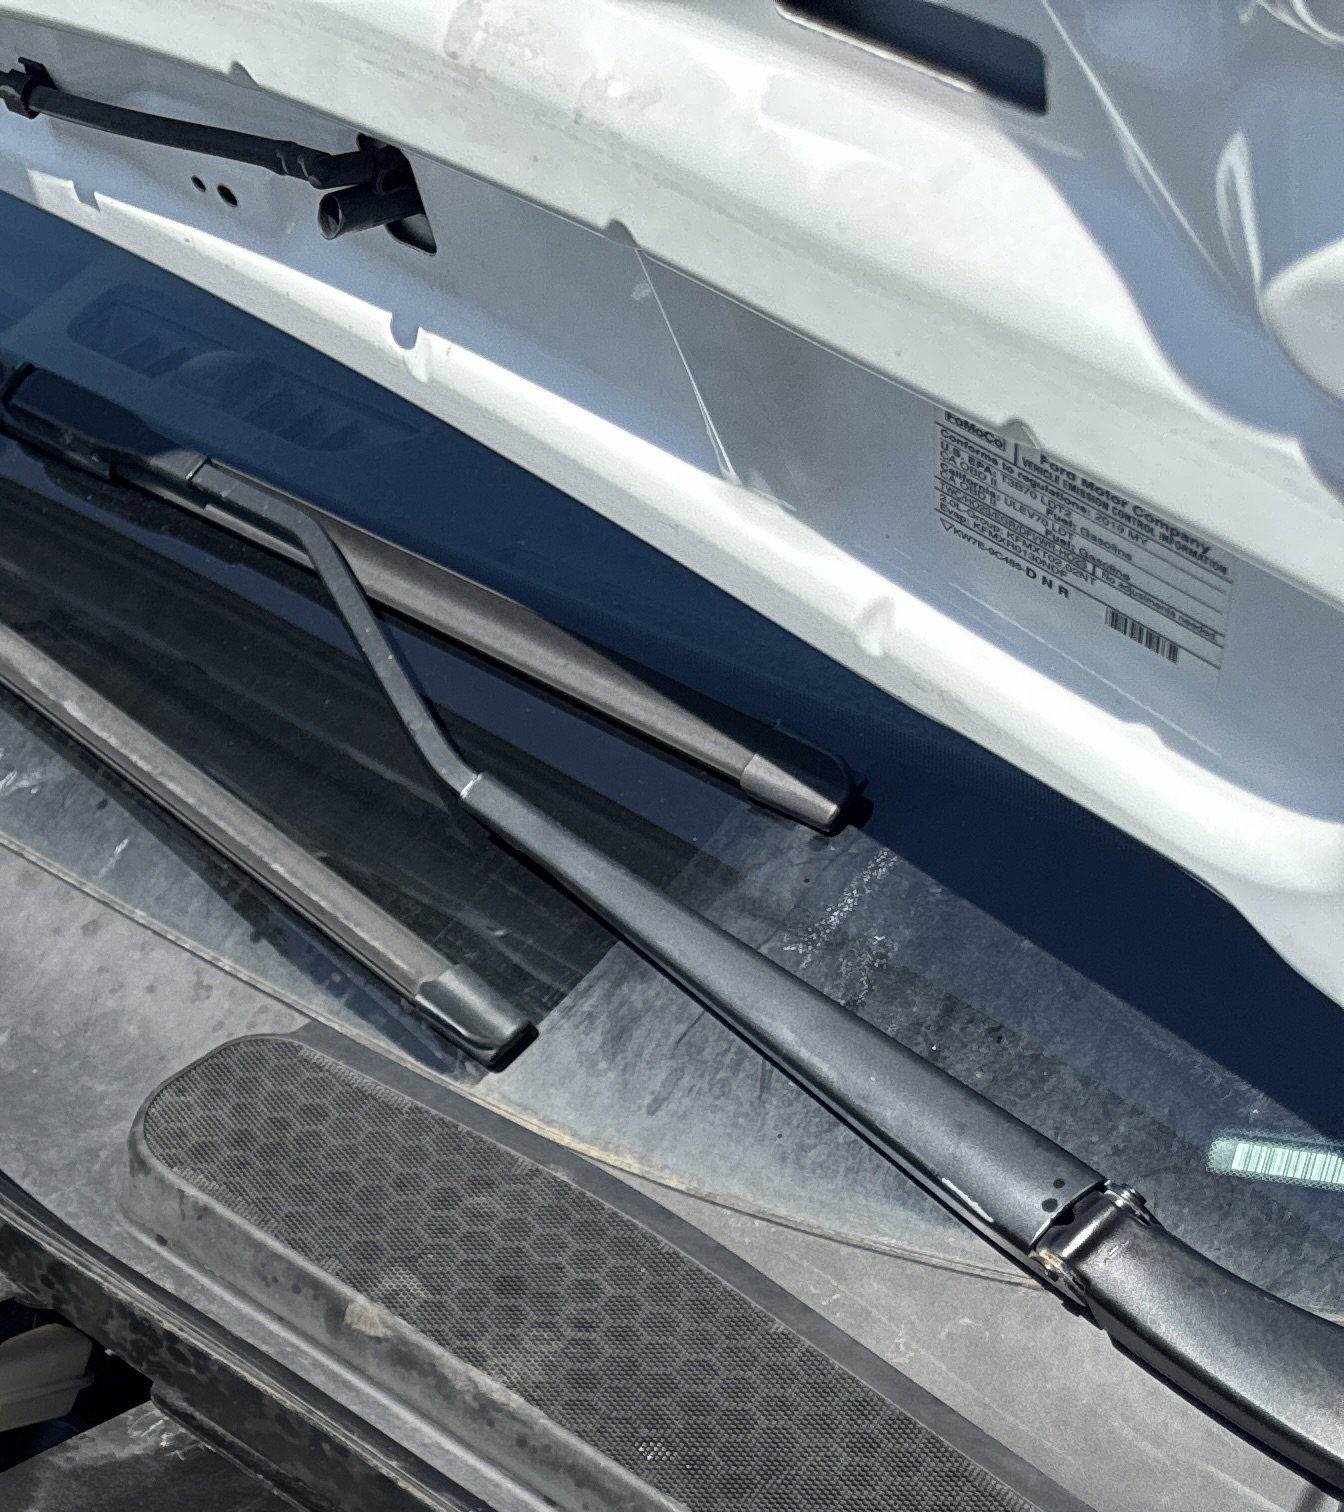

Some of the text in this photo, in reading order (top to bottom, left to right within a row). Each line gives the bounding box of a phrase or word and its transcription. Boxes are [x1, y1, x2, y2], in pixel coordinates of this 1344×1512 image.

[940, 440, 1071, 519] U.S. EPA: T3B70 LDT2
[945, 409, 1004, 451] FoMoCo
[940, 427, 998, 467] Conforms
[1017, 469, 1090, 518] regulations:
[1094, 511, 1124, 534] 2019
[1127, 529, 1148, 548] MY
[940, 449, 956, 466] CA
[959, 459, 986, 482] OBD
[1080, 526, 1133, 562] Gasoline
[940, 468, 956, 485] CA
[959, 479, 986, 502] OBD
[1078, 546, 1131, 582] Gasoline
[1004, 496, 1048, 528] ULEV70
[1051, 522, 1073, 542] LDT
[1021, 456, 1227, 576] VEHICLE EMISSION CONTROL INFORMATION
[1039, 453, 1211, 557] Ford Motor Company
[1117, 579, 1176, 620] adjustments
